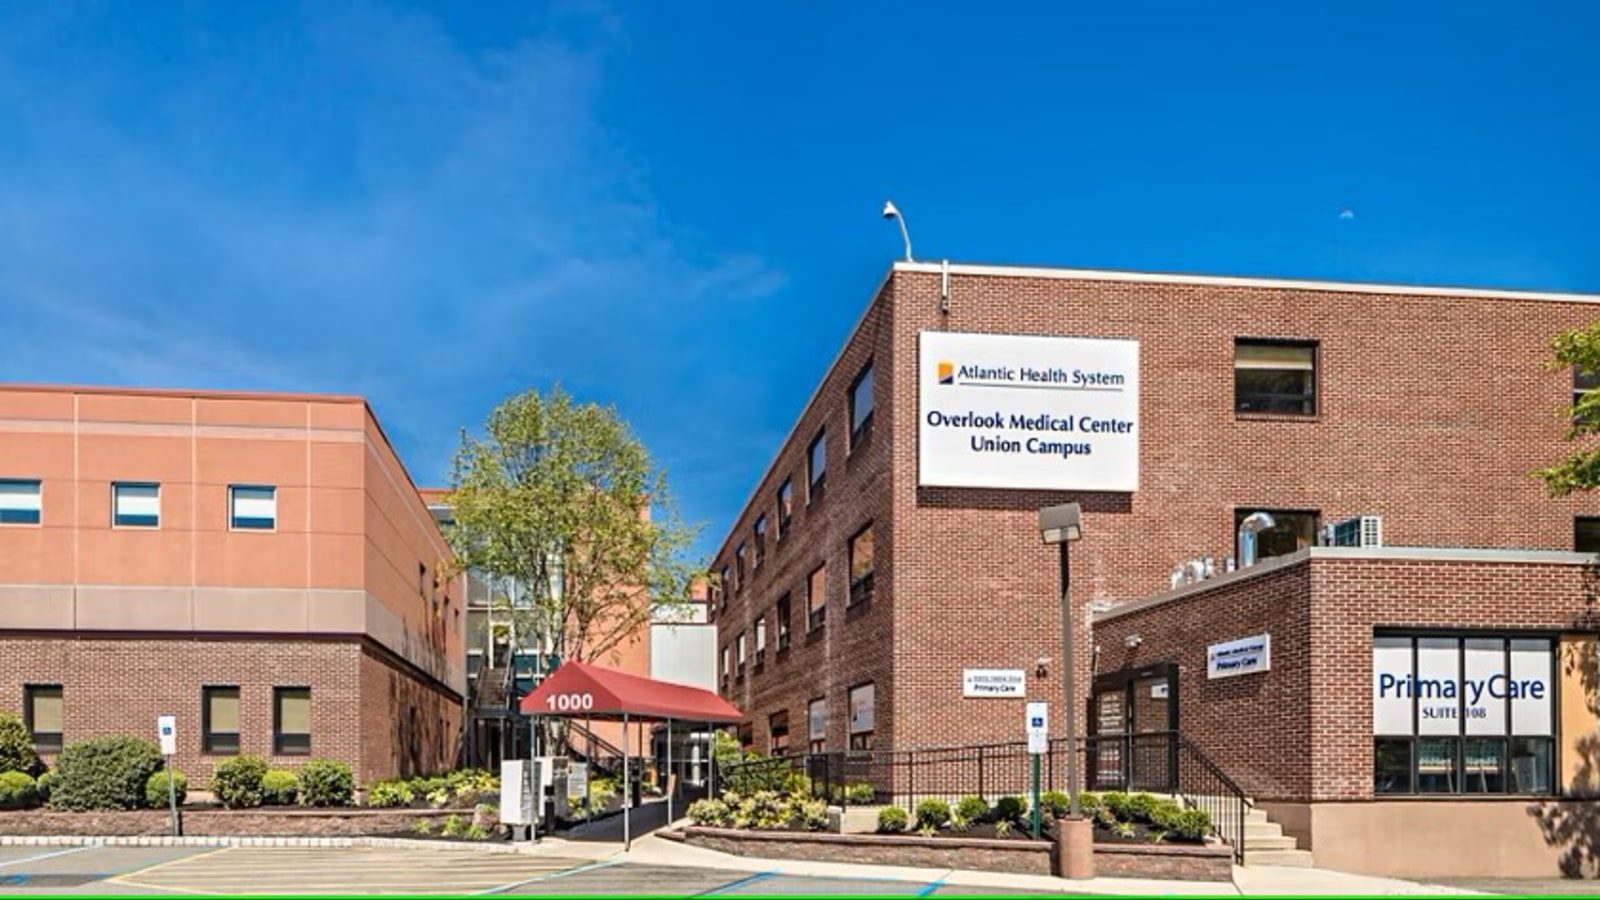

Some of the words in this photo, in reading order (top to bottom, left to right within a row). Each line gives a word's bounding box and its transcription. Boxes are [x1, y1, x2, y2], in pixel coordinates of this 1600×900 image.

[957, 365, 1014, 381] Atlantic
[1020, 368, 1068, 383] Health
[1072, 371, 1125, 388] System
[927, 411, 1005, 428] Overlook
[1009, 414, 1074, 432] Medical
[1078, 417, 1134, 433] Center
[970, 436, 1021, 452] Union
[1026, 438, 1092, 459] Campus
[1488, 674, 1545, 699] Care
[546, 693, 593, 710] 1000
[1422, 707, 1458, 719] SUITE
[1466, 707, 1487, 719] 108
